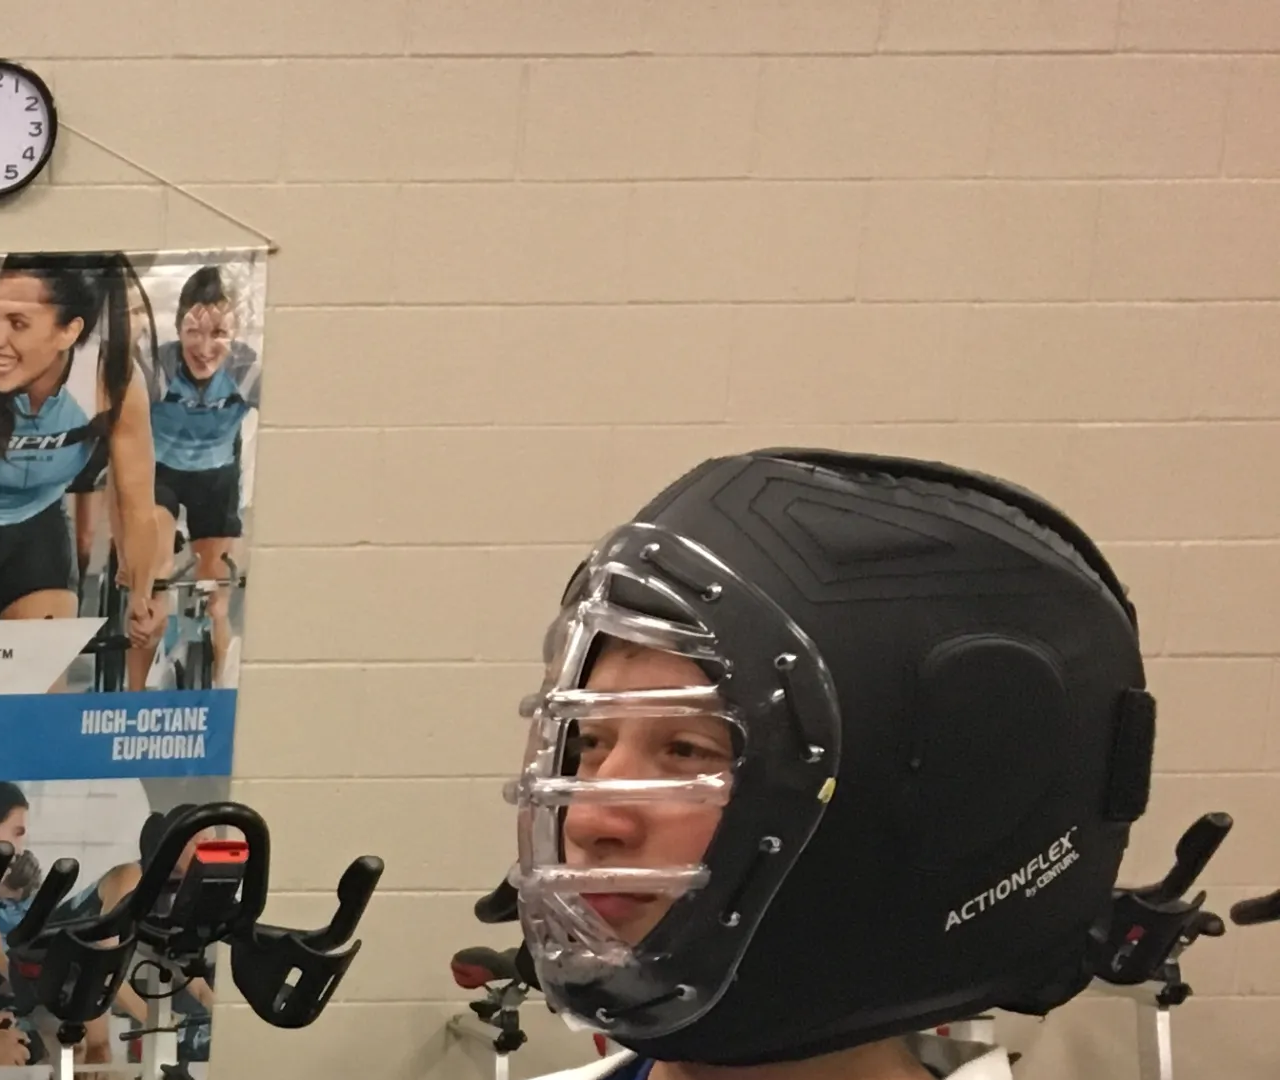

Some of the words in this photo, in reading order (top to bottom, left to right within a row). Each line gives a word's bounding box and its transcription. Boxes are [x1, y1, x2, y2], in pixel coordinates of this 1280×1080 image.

[24, 96, 40, 111] 2
[28, 121, 42, 137] 3
[22, 146, 35, 161] 4
[4, 164, 19, 180] 5
[81, 707, 209, 734] HIGH-OCTANE
[112, 734, 206, 760] EUPHORIA
[944, 831, 1073, 932] ACTIONFLEX
